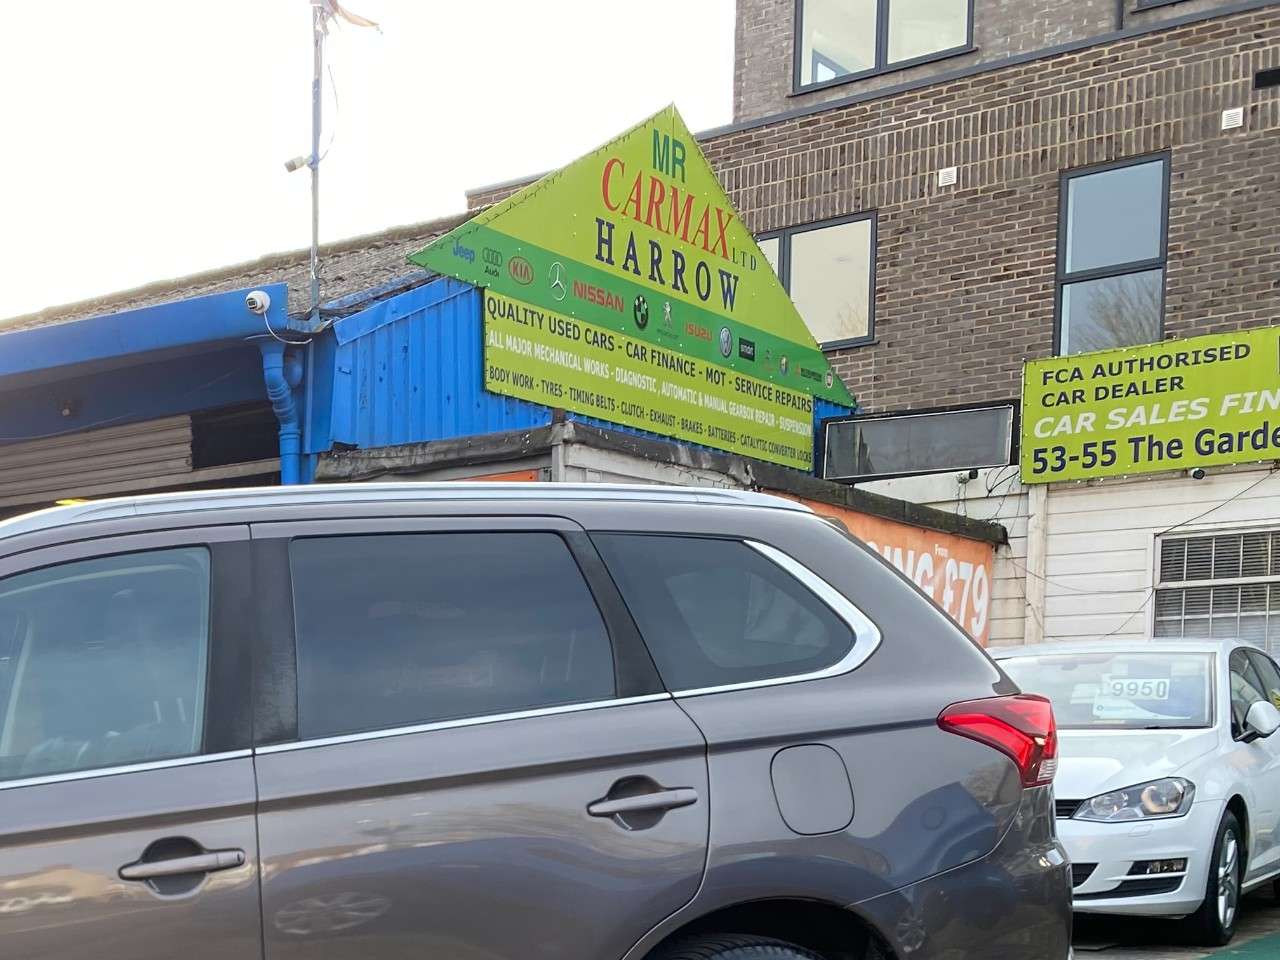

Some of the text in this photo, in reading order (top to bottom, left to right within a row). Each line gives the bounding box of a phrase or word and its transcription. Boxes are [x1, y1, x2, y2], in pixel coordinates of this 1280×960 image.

[652, 128, 686, 183] MR
[601, 158, 757, 271] CARMAX LTD
[453, 239, 475, 264] Jeep
[484, 265, 500, 278] Audi
[511, 263, 530, 282] KIA
[595, 217, 739, 312] HARROW
[573, 280, 624, 312] NISSAN
[486, 297, 544, 330] QUALITY
[548, 316, 580, 341] USED
[584, 328, 615, 351] CARS
[626, 341, 648, 362] CAR
[651, 349, 696, 377] FINANCE
[706, 367, 726, 387] MOT
[735, 376, 773, 402] SERVICE
[775, 389, 812, 413] REPAIRS
[489, 330, 504, 349] ALL
[505, 335, 533, 355] MAJOR
[534, 341, 583, 372] MECHANICAL
[584, 357, 610, 378] WORKS
[615, 367, 657, 393] DIAGNOSTIC
[662, 381, 698, 405] AUTOMATIC
[704, 394, 728, 414] MANUAL
[729, 402, 755, 421] GEARBOX
[1042, 343, 1252, 386] FCA AUTHORISED
[489, 366, 511, 384] BODY
[512, 371, 534, 390] WORK
[541, 380, 563, 398] TYRES
[570, 387, 595, 406] TIMING
[595, 394, 616, 412] BELTS
[621, 401, 645, 419] CLUTCH
[650, 409, 676, 427] EXHAUST
[680, 417, 703, 435] BRAKES
[708, 425, 736, 444] BATTERIES
[1041, 375, 1185, 408] CAR DEALER
[1034, 411, 1097, 439] CAR
[1105, 397, 1210, 430] SALES
[1032, 439, 1117, 475] 53-55
[1128, 435, 1184, 464] The
